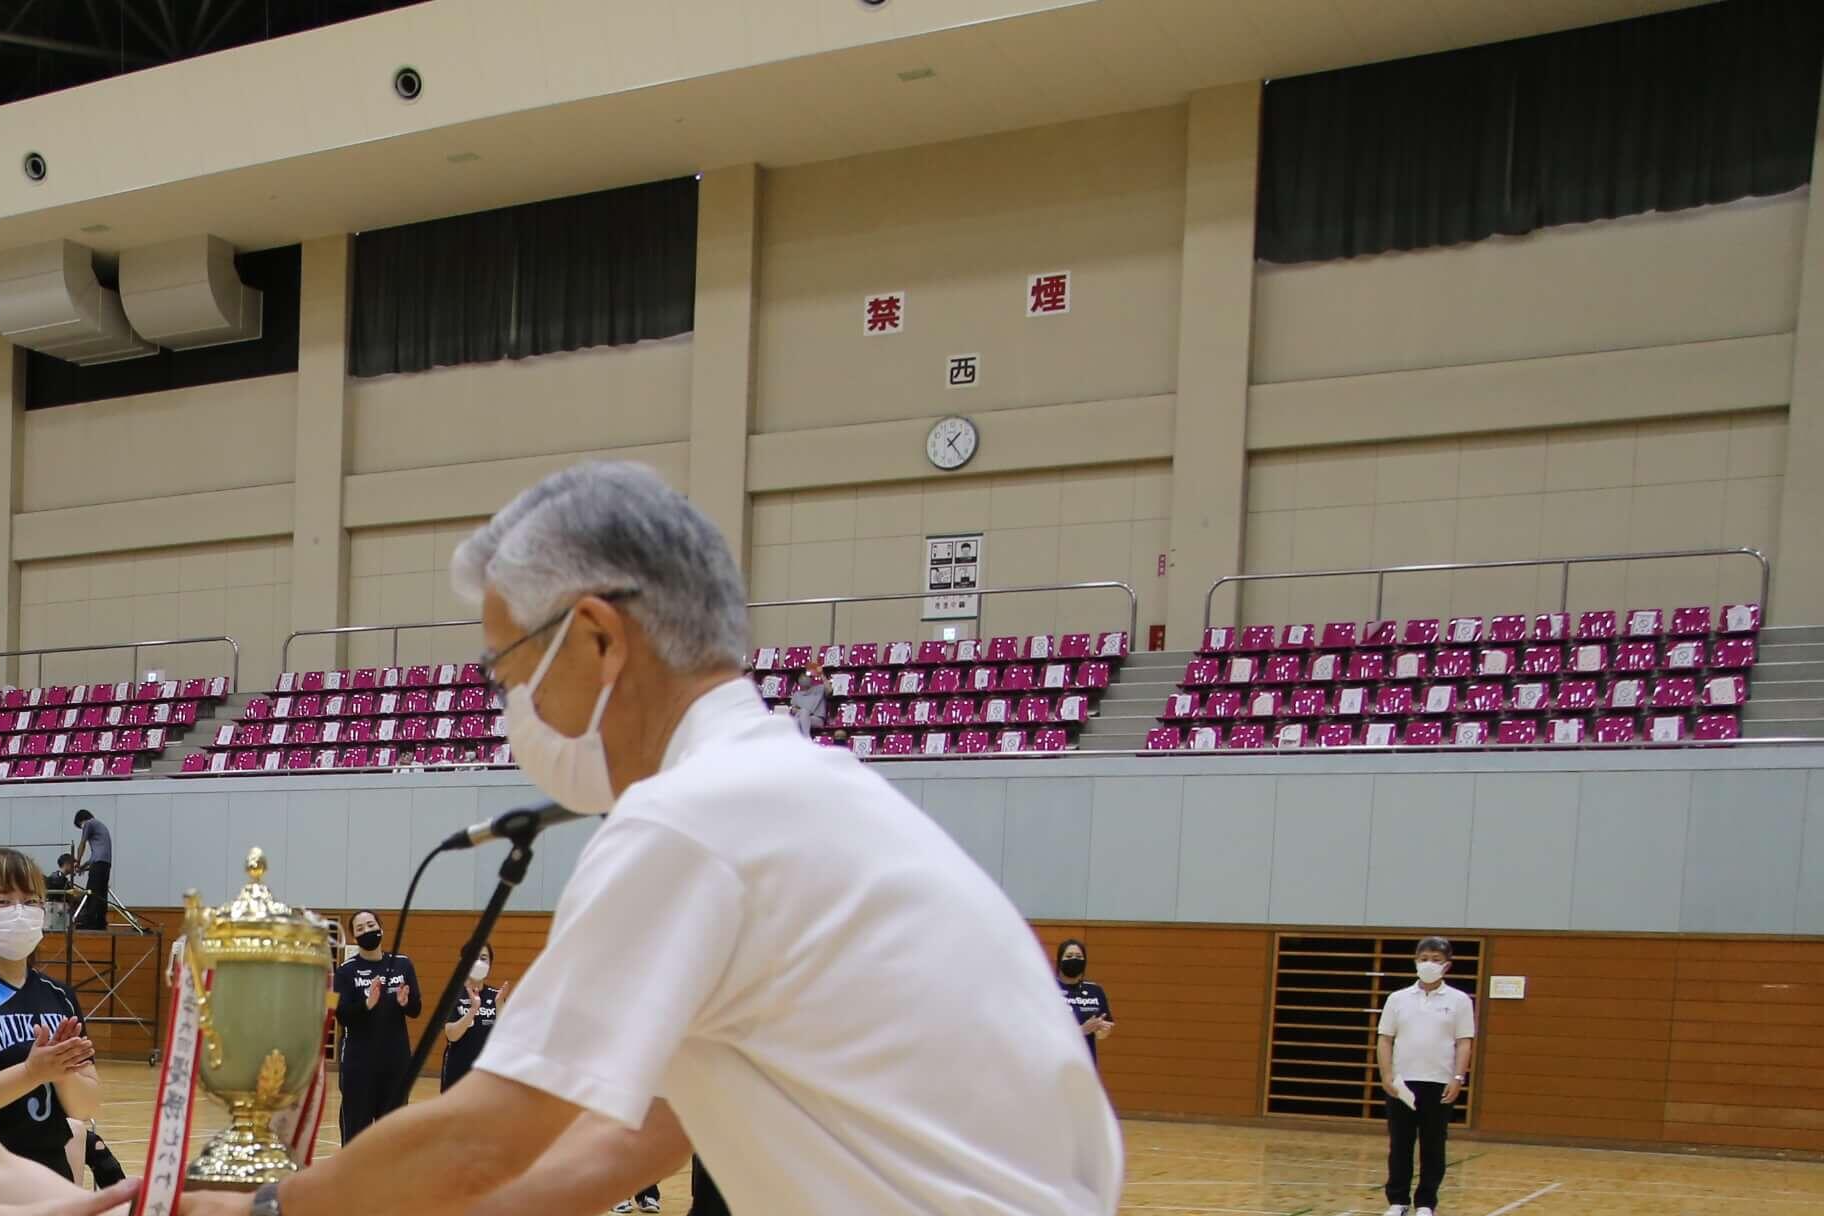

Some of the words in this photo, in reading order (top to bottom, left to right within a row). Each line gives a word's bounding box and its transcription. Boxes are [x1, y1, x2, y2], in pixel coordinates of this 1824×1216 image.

[867, 296, 901, 331] 禁
[1030, 274, 1067, 312] 煙
[949, 356, 977, 385] 西
